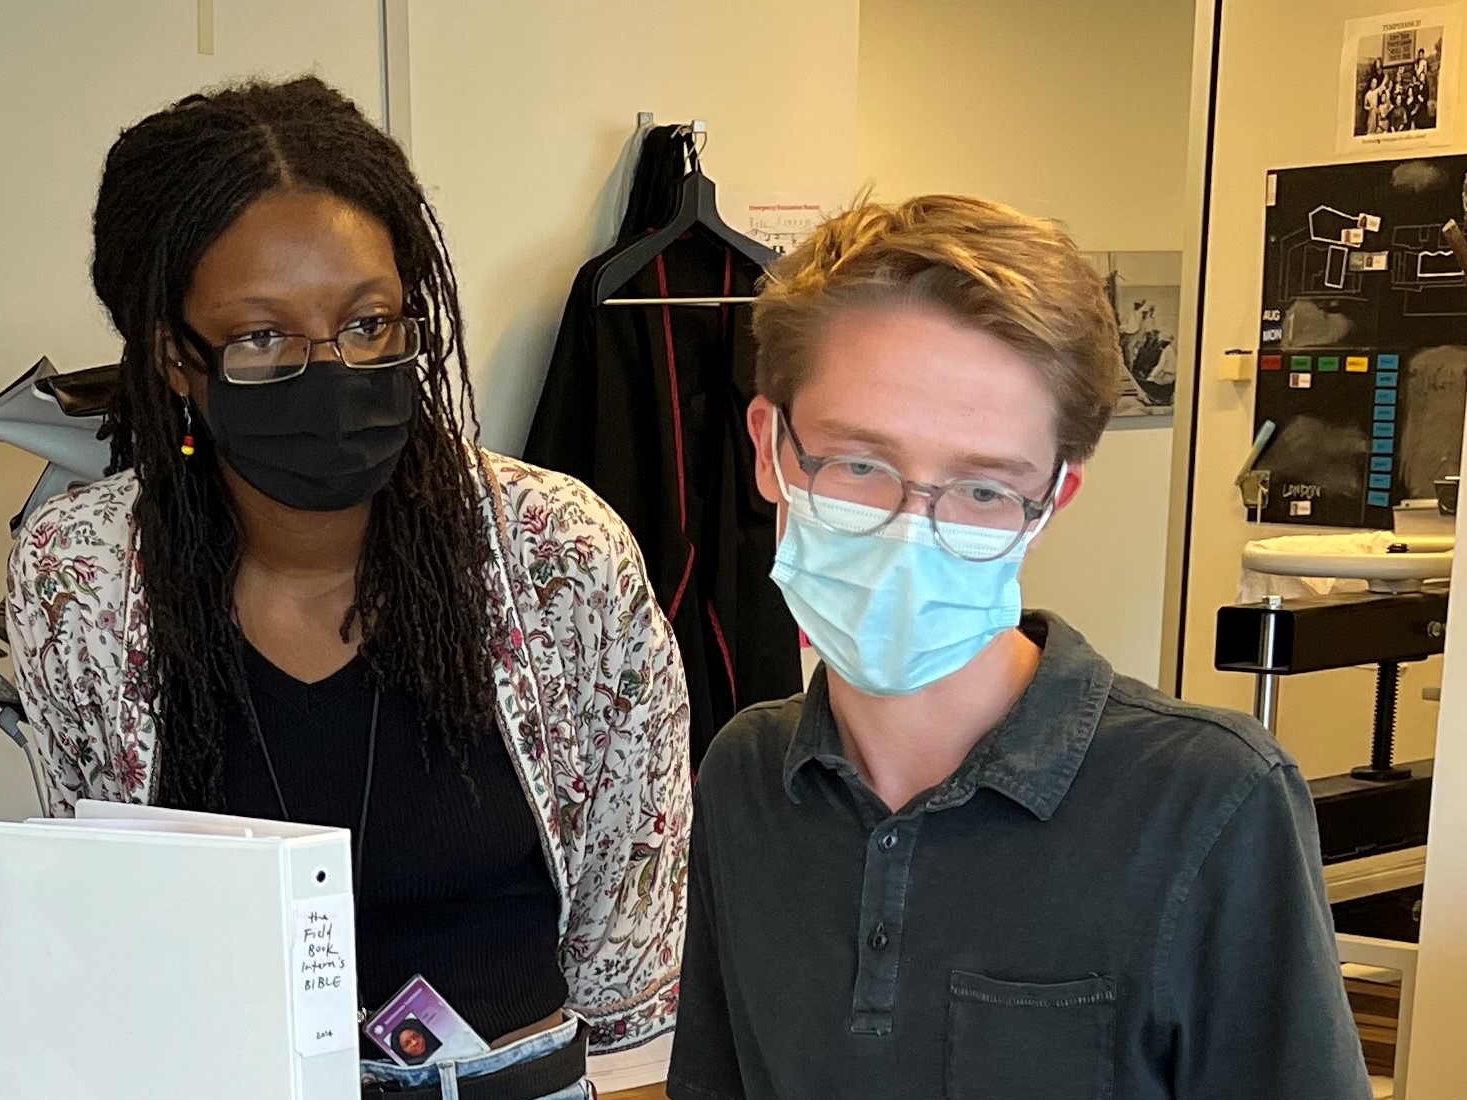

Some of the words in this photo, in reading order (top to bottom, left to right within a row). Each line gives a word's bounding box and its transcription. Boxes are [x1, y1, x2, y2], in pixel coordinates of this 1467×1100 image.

[1262, 309, 1281, 322] AUG
[1262, 328, 1282, 342] MON
[308, 911, 329, 923] the
[303, 923, 333, 943] Field
[308, 943, 340, 958] Book
[304, 976, 342, 991] BIBLE
